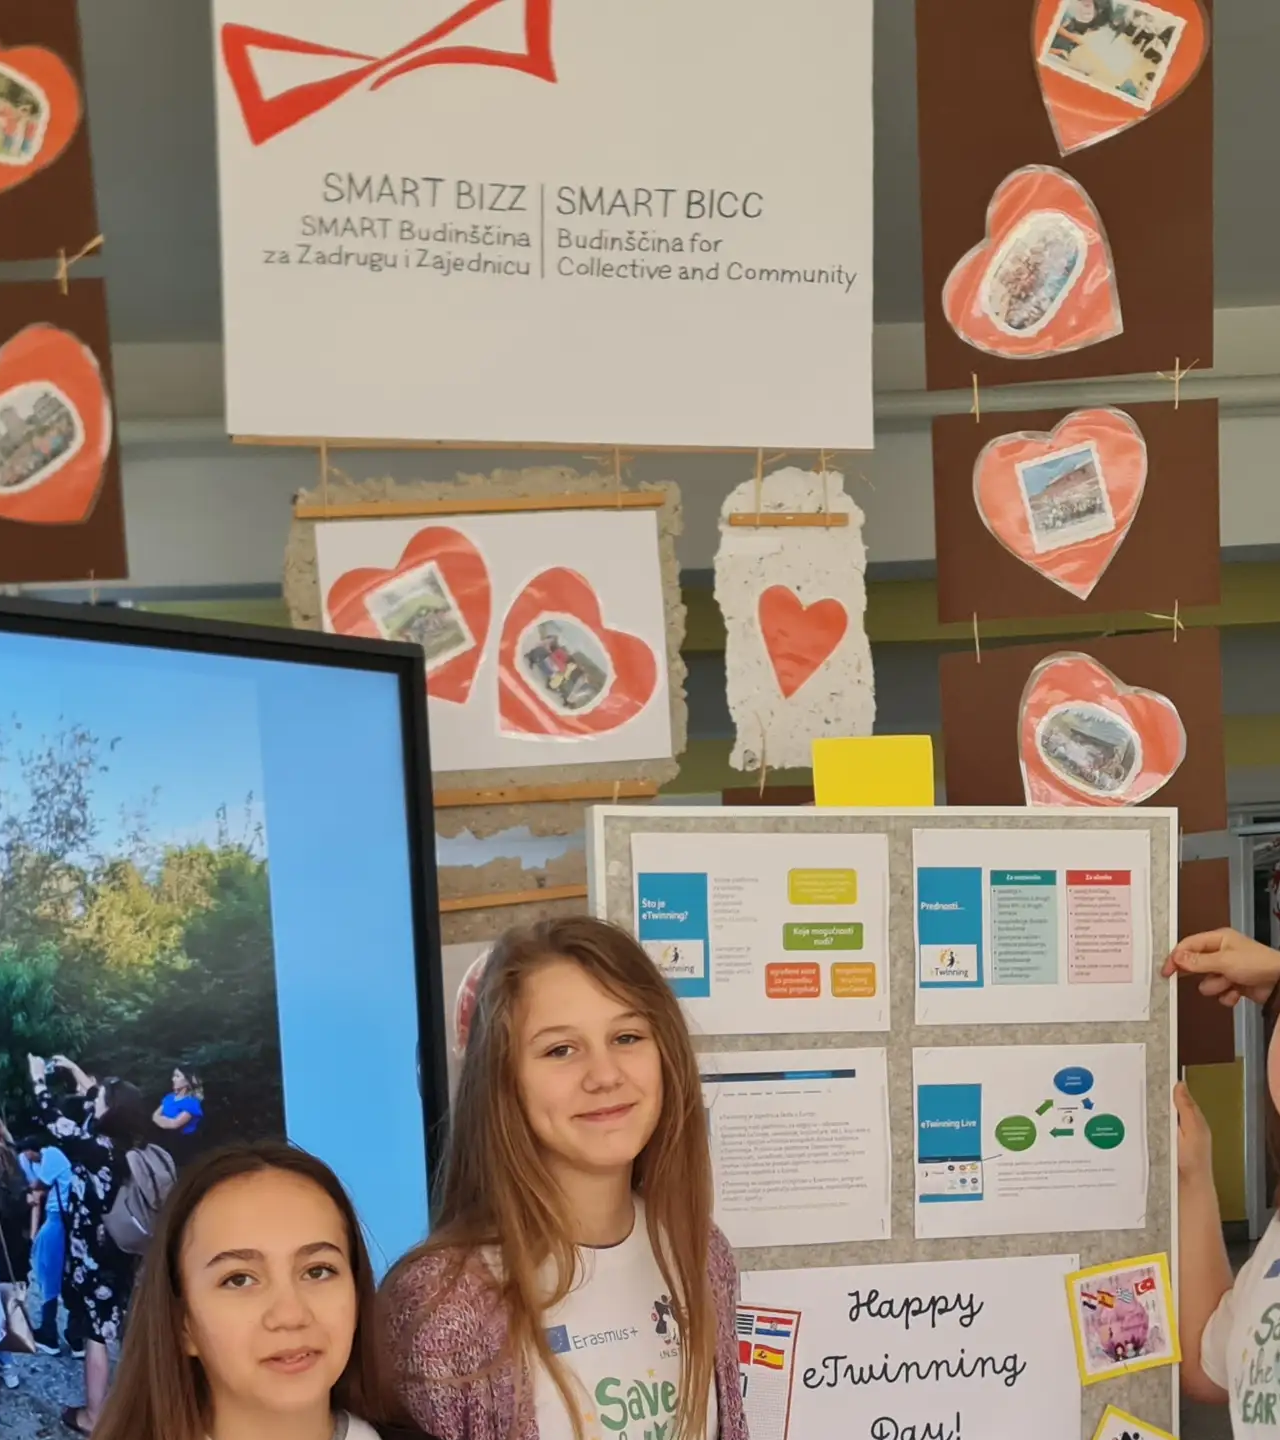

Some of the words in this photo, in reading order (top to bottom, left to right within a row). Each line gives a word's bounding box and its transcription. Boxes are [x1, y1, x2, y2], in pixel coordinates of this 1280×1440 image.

[322, 171, 446, 208] SMART
[455, 179, 528, 212] BIZZ
[555, 185, 677, 219] SMART
[685, 188, 764, 220] BICC
[300, 214, 394, 240] SMART
[399, 219, 532, 248] Budinščina
[557, 227, 685, 253] Budinščina
[690, 232, 723, 254] for
[262, 249, 291, 266] za
[295, 243, 398, 272] Zadrugu
[404, 248, 411, 269] i
[415, 247, 531, 277] Zajednicu
[556, 256, 672, 281] Collective
[677, 261, 720, 282] and
[726, 261, 858, 294] Community
[920, 1118, 960, 1130] eTwinning
[961, 1118, 977, 1128] Live
[847, 1287, 985, 1331] Happy
[571, 1326, 639, 1350] Erasmus+
[802, 1347, 1027, 1390] eTwinning
[594, 1376, 680, 1432] Save
